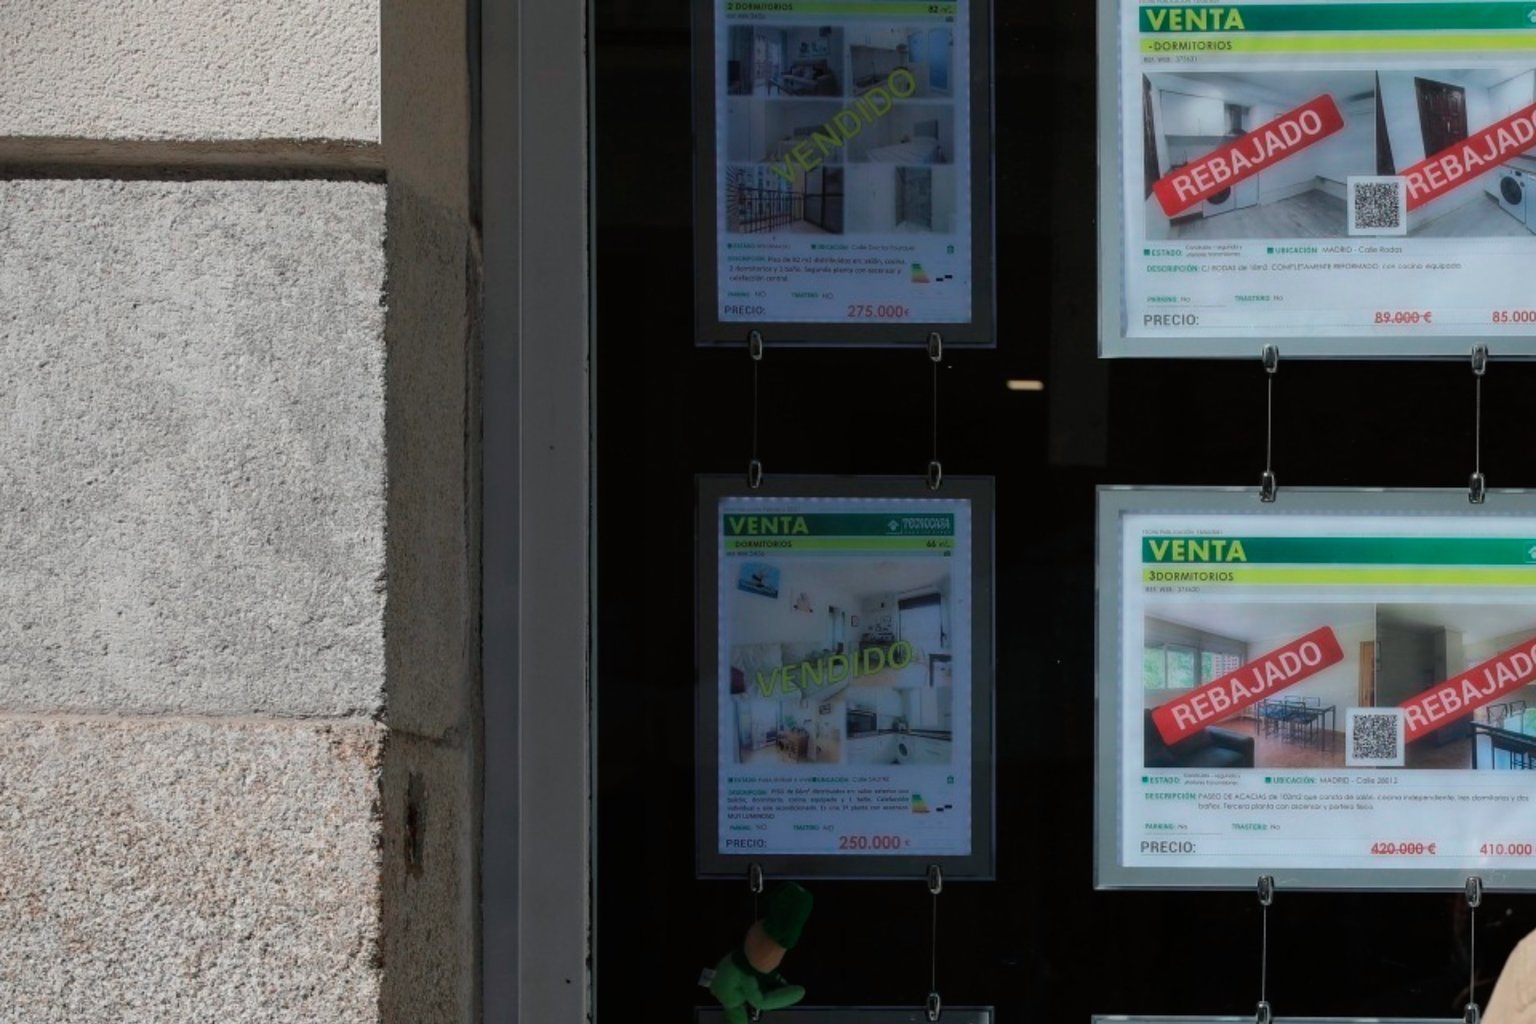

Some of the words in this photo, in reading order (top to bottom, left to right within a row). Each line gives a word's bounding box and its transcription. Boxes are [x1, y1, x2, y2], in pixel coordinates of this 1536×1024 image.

[735, 2, 793, 10] DORMITORIOS
[1146, 8, 1245, 31] VENTA
[771, 68, 917, 185] VENDIDO
[1171, 108, 1323, 204] REBAJADO
[1321, 246, 1353, 254] MADRID
[1358, 246, 1378, 254] Calle
[1379, 245, 1403, 254] Rodas
[724, 305, 766, 316] PRECIO:
[1374, 311, 1420, 324] 89.000
[1423, 311, 1433, 322] €
[1143, 313, 1200, 327] PRECIO:
[729, 516, 809, 534] VENTA
[735, 540, 793, 549] DORMITORIOS
[1148, 539, 1248, 562] VENTA
[756, 640, 913, 698] VENDIDO
[1170, 640, 1323, 731] REBAJADO
[1319, 776, 1350, 785] MADRID
[725, 838, 767, 850] PRECIO:
[839, 835, 901, 850] 250.000
[1140, 840, 1196, 854] PRECIO:
[1371, 842, 1423, 856] 420.000
[1427, 843, 1437, 855] €
[1479, 843, 1533, 857] 410.000
